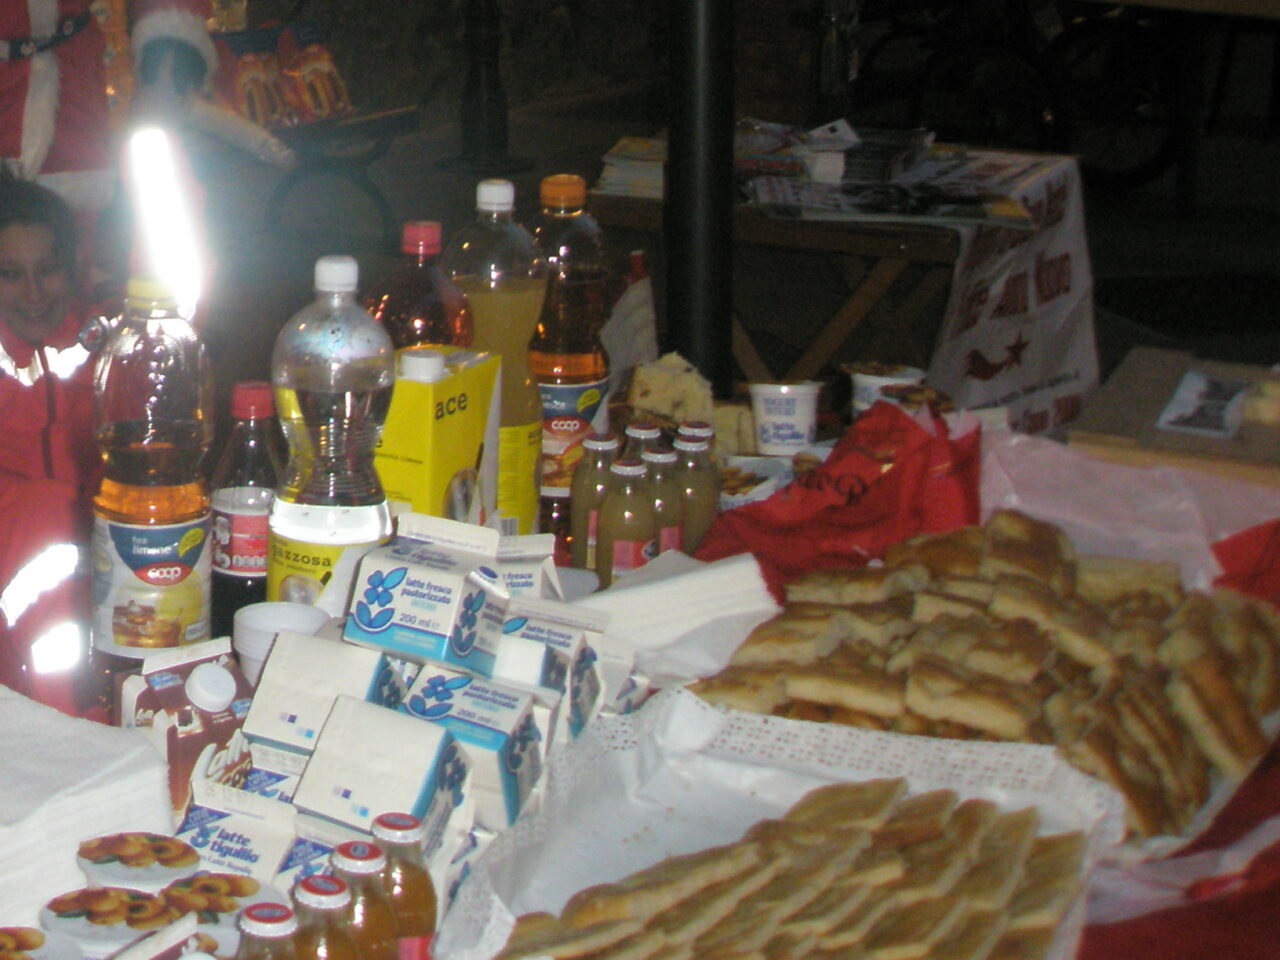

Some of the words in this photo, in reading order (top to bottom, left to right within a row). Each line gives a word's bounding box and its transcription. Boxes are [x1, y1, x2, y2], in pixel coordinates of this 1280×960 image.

[434, 392, 469, 420] ace
[132, 544, 171, 555] limone
[147, 566, 182, 581] coop
[405, 578, 426, 590] latte
[426, 581, 453, 595] fresco
[506, 580, 534, 588] rizzato
[401, 587, 452, 605] pastorizzato
[399, 612, 417, 625] 200
[217, 828, 251, 846] latte
